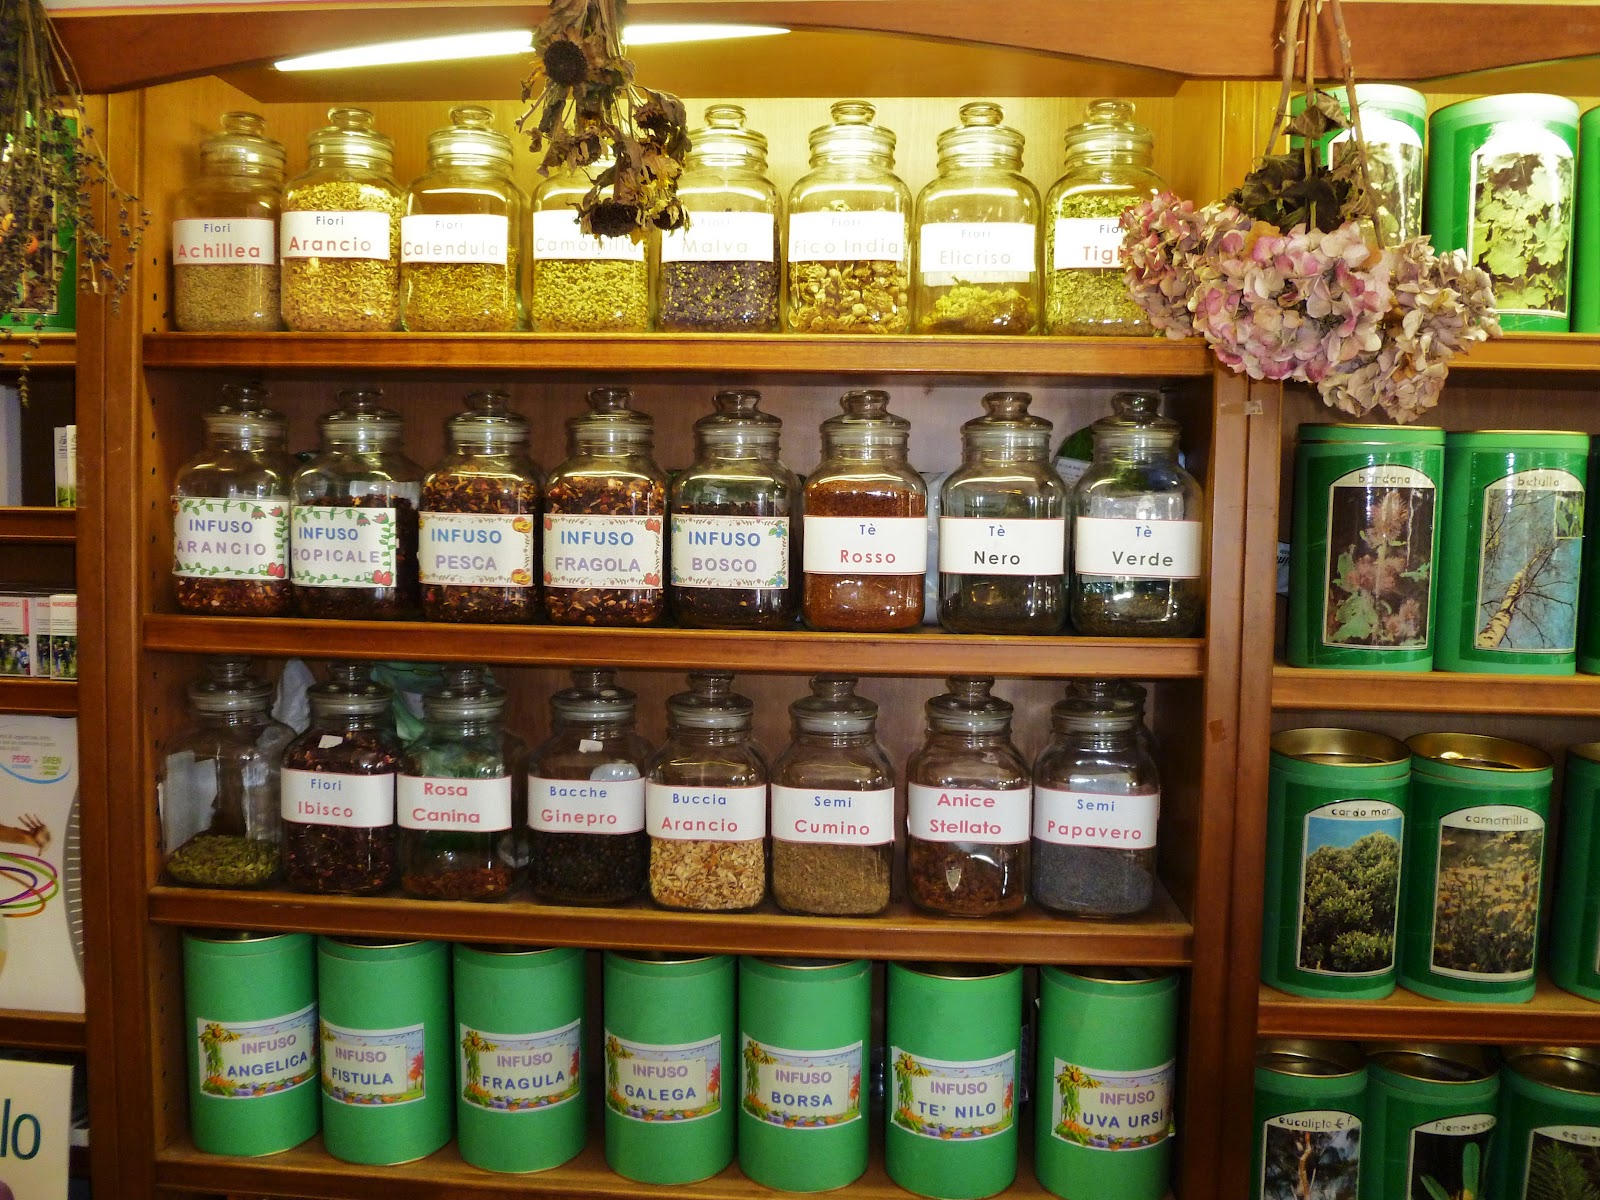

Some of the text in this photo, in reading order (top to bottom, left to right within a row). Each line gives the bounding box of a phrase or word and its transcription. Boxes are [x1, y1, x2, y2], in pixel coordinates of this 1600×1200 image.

[203, 223, 232, 233] Fiori
[315, 216, 345, 226] Fiori
[435, 220, 464, 230] Fiori
[1099, 224, 1124, 234] Fior
[177, 242, 261, 259] Achillea
[288, 236, 372, 252] Arancio
[403, 241, 498, 257] Calendula
[682, 239, 748, 253] Malva
[794, 238, 898, 254] Fico India
[940, 250, 1011, 265] Elicriso
[1082, 245, 1121, 265] Tigl
[188, 519, 253, 534] INFUSO
[298, 526, 359, 541] INFUSO
[859, 522, 877, 536] Tè
[989, 524, 1006, 537] Tè
[1135, 525, 1153, 538] Tè
[430, 528, 502, 544] INFUSO
[560, 530, 635, 546] INFUSO
[688, 530, 761, 547] INFUSO
[176, 540, 267, 556] ARANCIO
[291, 548, 380, 563] ROPICALE
[435, 555, 498, 571] PESCA
[555, 556, 641, 572] FRAGOLA
[840, 549, 896, 564] Rosso
[973, 550, 1021, 566] Nero
[1112, 551, 1174, 567] Verde
[691, 557, 757, 573] BOSCO
[310, 778, 342, 791] Fiori
[423, 782, 468, 797] Rosa
[549, 786, 608, 798] Bacche
[672, 793, 727, 806] Buccia
[814, 795, 852, 808] Semi
[937, 793, 996, 808] Anice
[1076, 799, 1115, 812] Semi
[298, 801, 354, 818] Ibisco
[412, 807, 480, 824] Canina
[1331, 807, 1367, 817] cardo
[541, 809, 617, 827] Ginepro
[661, 816, 738, 833] Arancio
[1465, 814, 1529, 825] camomilla
[794, 819, 870, 836] Cumino
[930, 819, 1002, 835] Stellato
[1047, 820, 1142, 840] Papavero
[241, 1033, 297, 1055] INFUSO
[335, 1046, 387, 1063] INFUSO
[496, 1051, 553, 1068] INFUSO
[227, 1051, 308, 1077] ANGELICA
[632, 1063, 688, 1079] INFUSO
[331, 1066, 394, 1085] FISTULA
[482, 1070, 565, 1090] FRAGULA
[775, 1068, 832, 1084] INFUSO
[624, 1084, 697, 1101] GALEGA
[930, 1081, 988, 1096] INFUSO
[771, 1091, 833, 1107] BORSA
[1099, 1090, 1156, 1106] INFUSO
[917, 1100, 996, 1119] TE' NILO
[1083, 1109, 1163, 1129] UVA URSI
[1278, 1116, 1332, 1131] eucalipto
